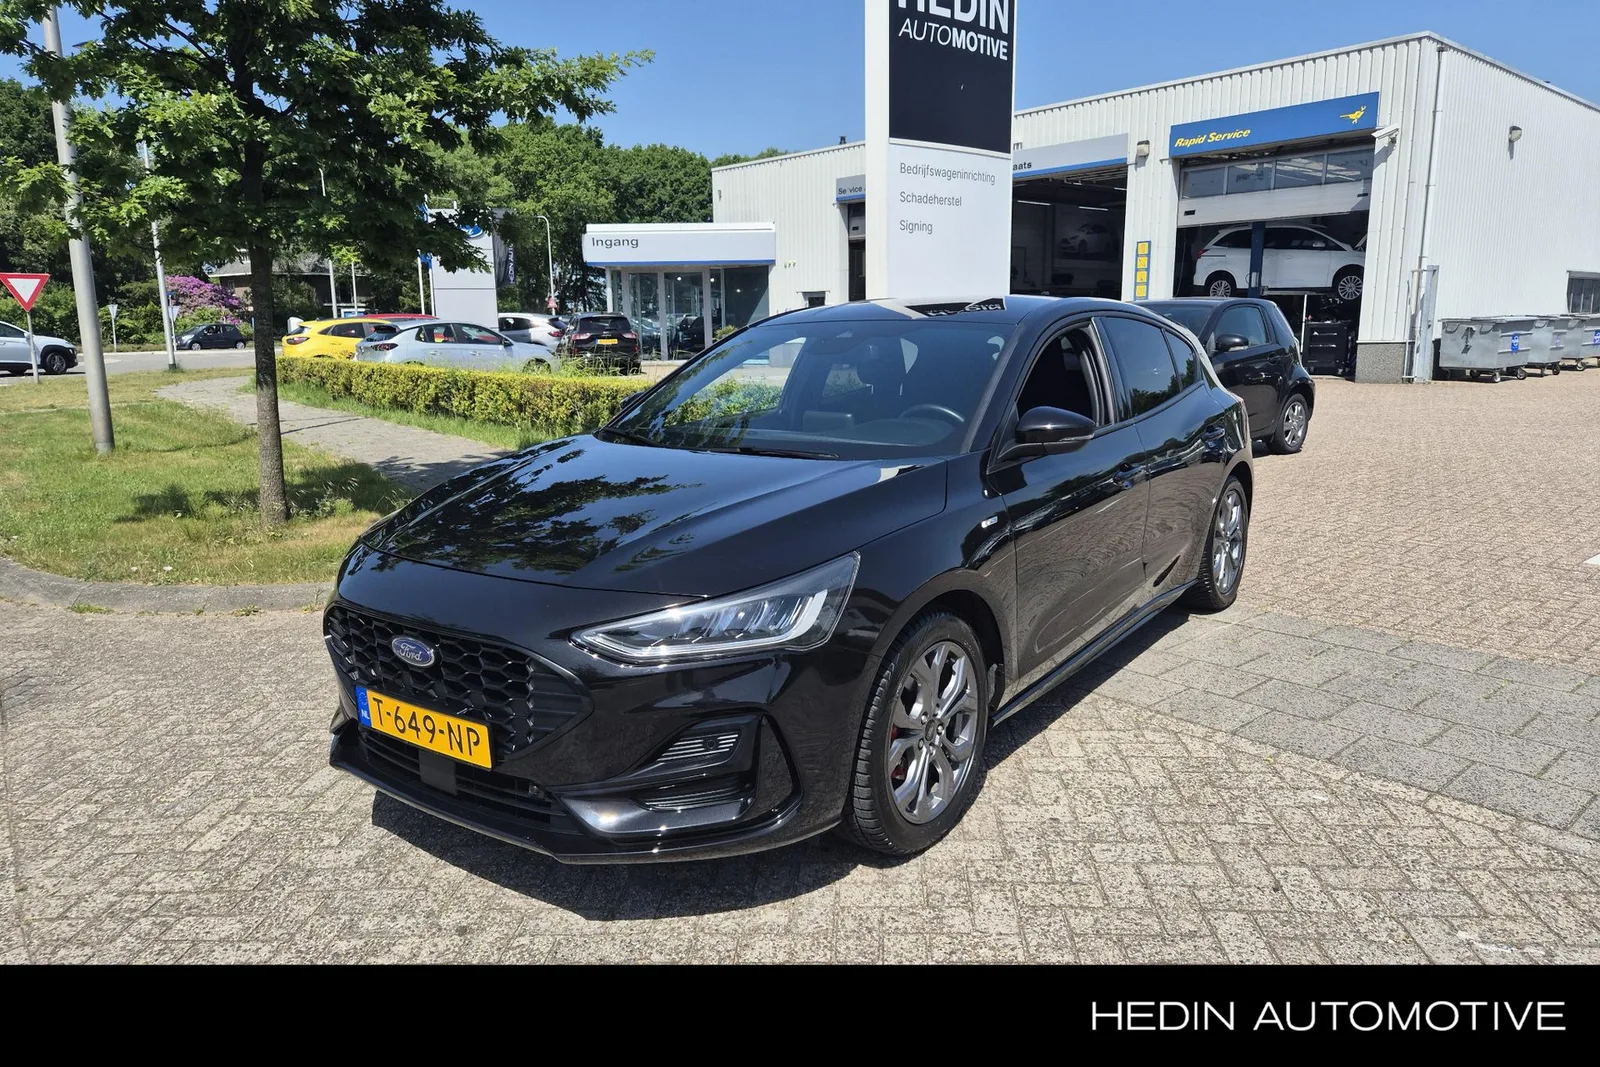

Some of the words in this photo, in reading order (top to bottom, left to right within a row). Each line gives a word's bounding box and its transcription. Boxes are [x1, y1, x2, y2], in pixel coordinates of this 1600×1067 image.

[898, 0, 1008, 34] DIN
[898, 17, 1008, 61] AUTOMOTIVE
[1174, 134, 1207, 148] Rapid
[1207, 129, 1251, 143] Service
[900, 162, 996, 186] Bedrijfswageninrichting
[838, 186, 863, 195] Sevice
[900, 190, 962, 207] Schadeherstel
[900, 219, 933, 235] Signing
[591, 237, 639, 249] Ingang
[399, 642, 423, 661] Ford
[360, 708, 371, 720] NL
[372, 697, 480, 757] T-649-NP
